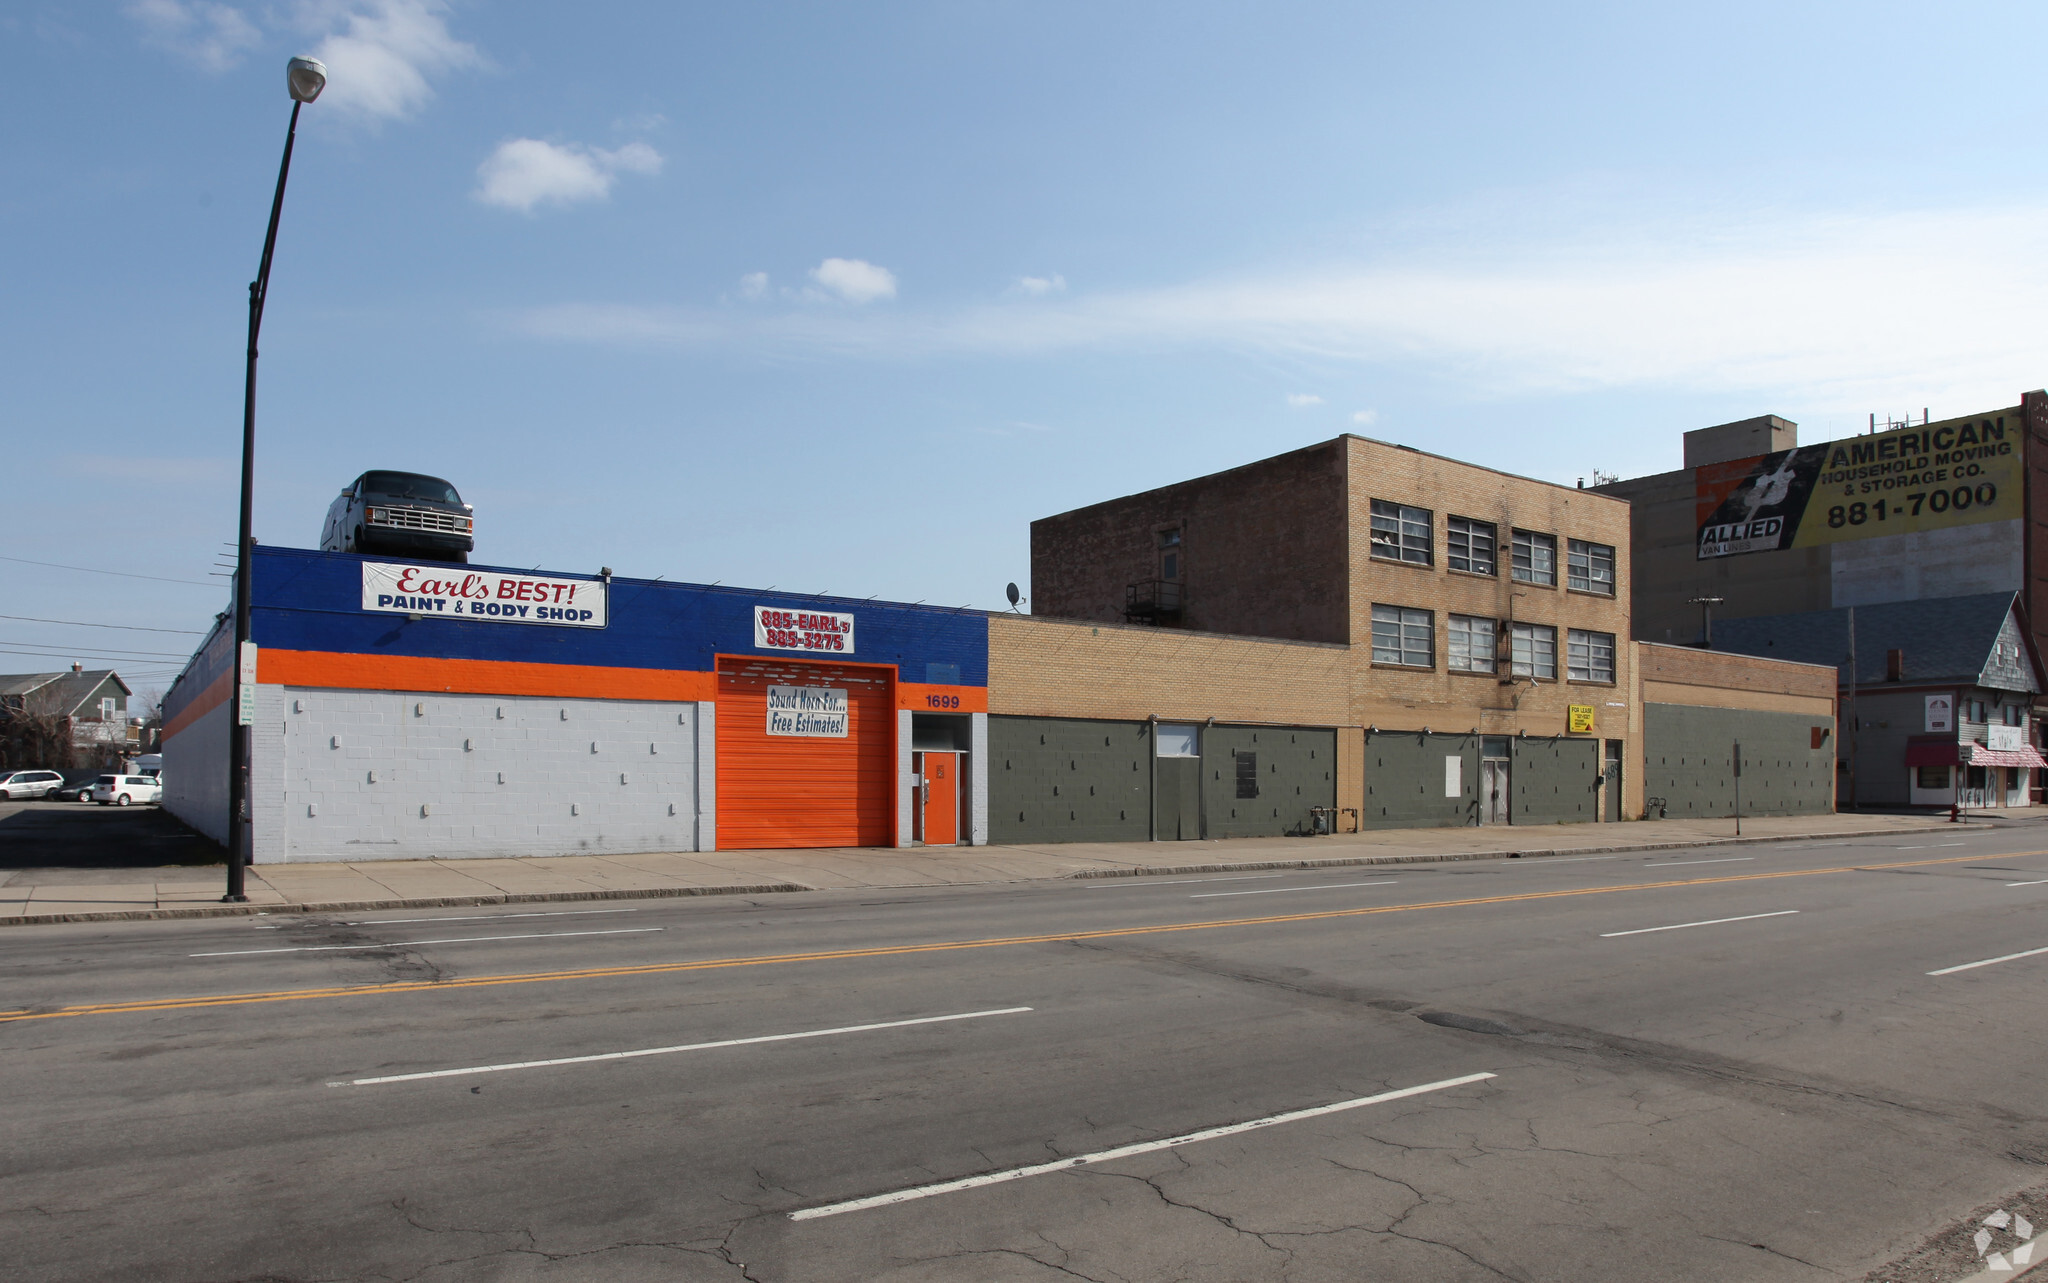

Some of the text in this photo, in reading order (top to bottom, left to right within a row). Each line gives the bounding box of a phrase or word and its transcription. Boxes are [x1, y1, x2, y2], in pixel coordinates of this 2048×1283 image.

[1829, 416, 2005, 469] AMERICAN
[1821, 441, 2012, 485] HOUSEHOLD MOVING
[1844, 463, 1985, 496] & STORAGE CO.
[1827, 482, 1997, 529] 881-7000
[1703, 518, 1781, 545] ALLIED
[1702, 540, 1751, 555] VAN LINES
[396, 567, 576, 605] Earl's BEST!
[378, 594, 593, 622] PAINT & BODY SHOP
[767, 629, 844, 651] 885-3275
[769, 688, 798, 709] Sound
[800, 689, 821, 711] Horn
[926, 695, 960, 709] 1699
[771, 711, 845, 734] Free Estimates!
